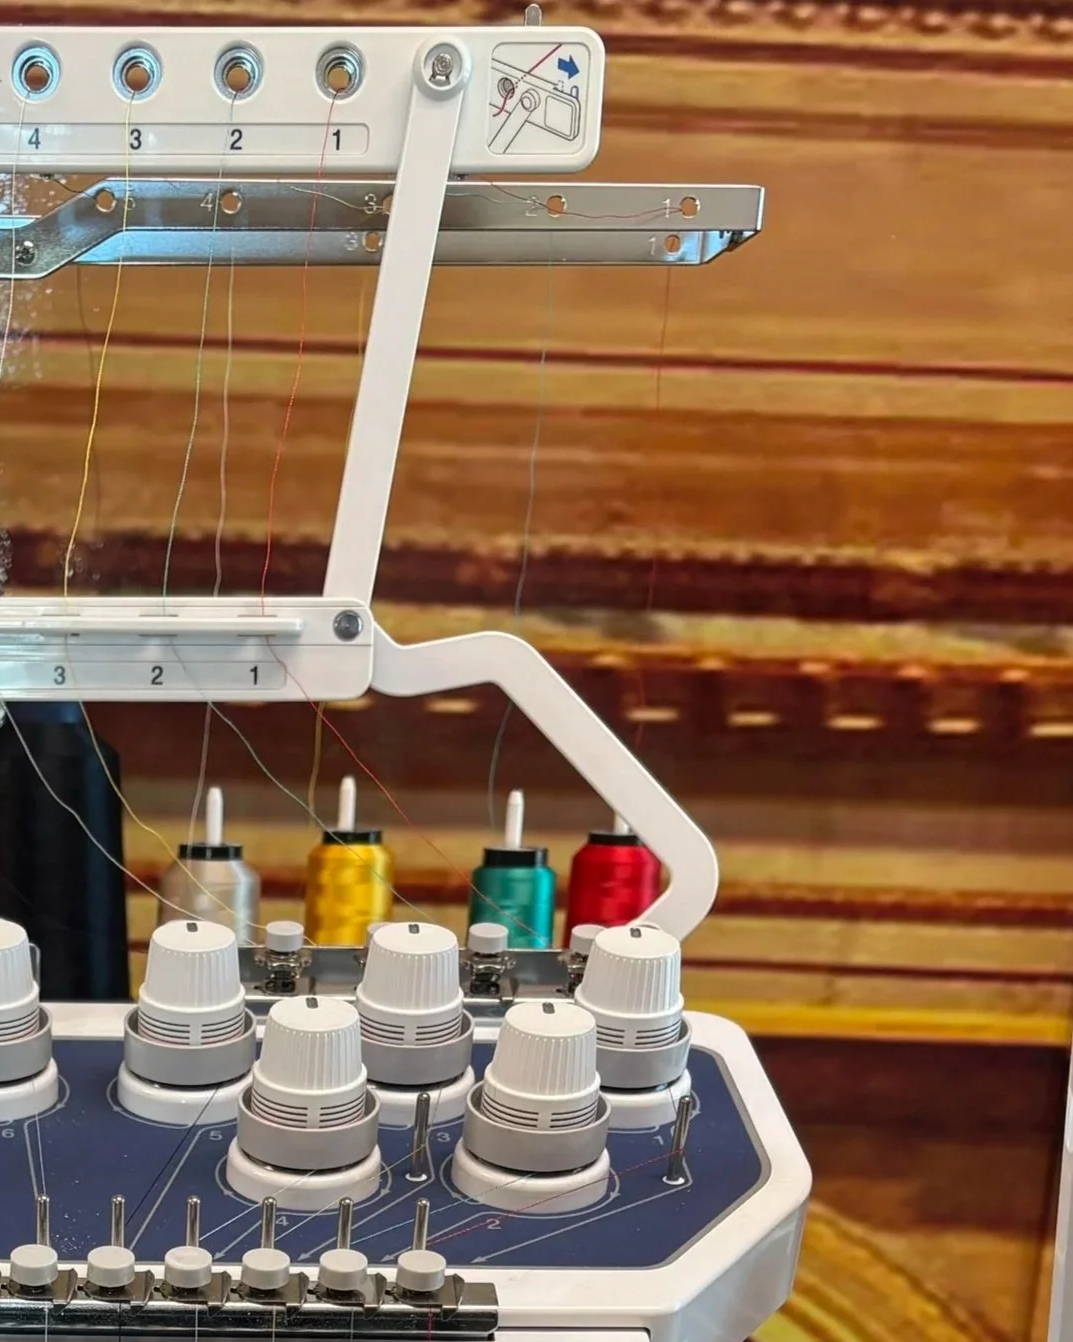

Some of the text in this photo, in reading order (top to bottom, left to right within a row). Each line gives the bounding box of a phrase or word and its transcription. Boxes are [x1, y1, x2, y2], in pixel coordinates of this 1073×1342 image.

[28, 129, 41, 149] 4
[129, 129, 143, 150] 3
[230, 129, 244, 150] 2
[332, 129, 342, 150] 1
[200, 193, 213, 211] 4
[662, 198, 670, 218] 1
[649, 236, 657, 255] 1
[53, 666, 66, 685] 3
[151, 666, 163, 685] 2
[249, 667, 258, 685] 1
[1, 1128, 14, 1138] 6
[209, 1131, 223, 1140] 5
[437, 1132, 450, 1142] 3
[652, 1136, 664, 1145] 1
[275, 1215, 289, 1227] 4
[486, 1218, 501, 1229] 2
